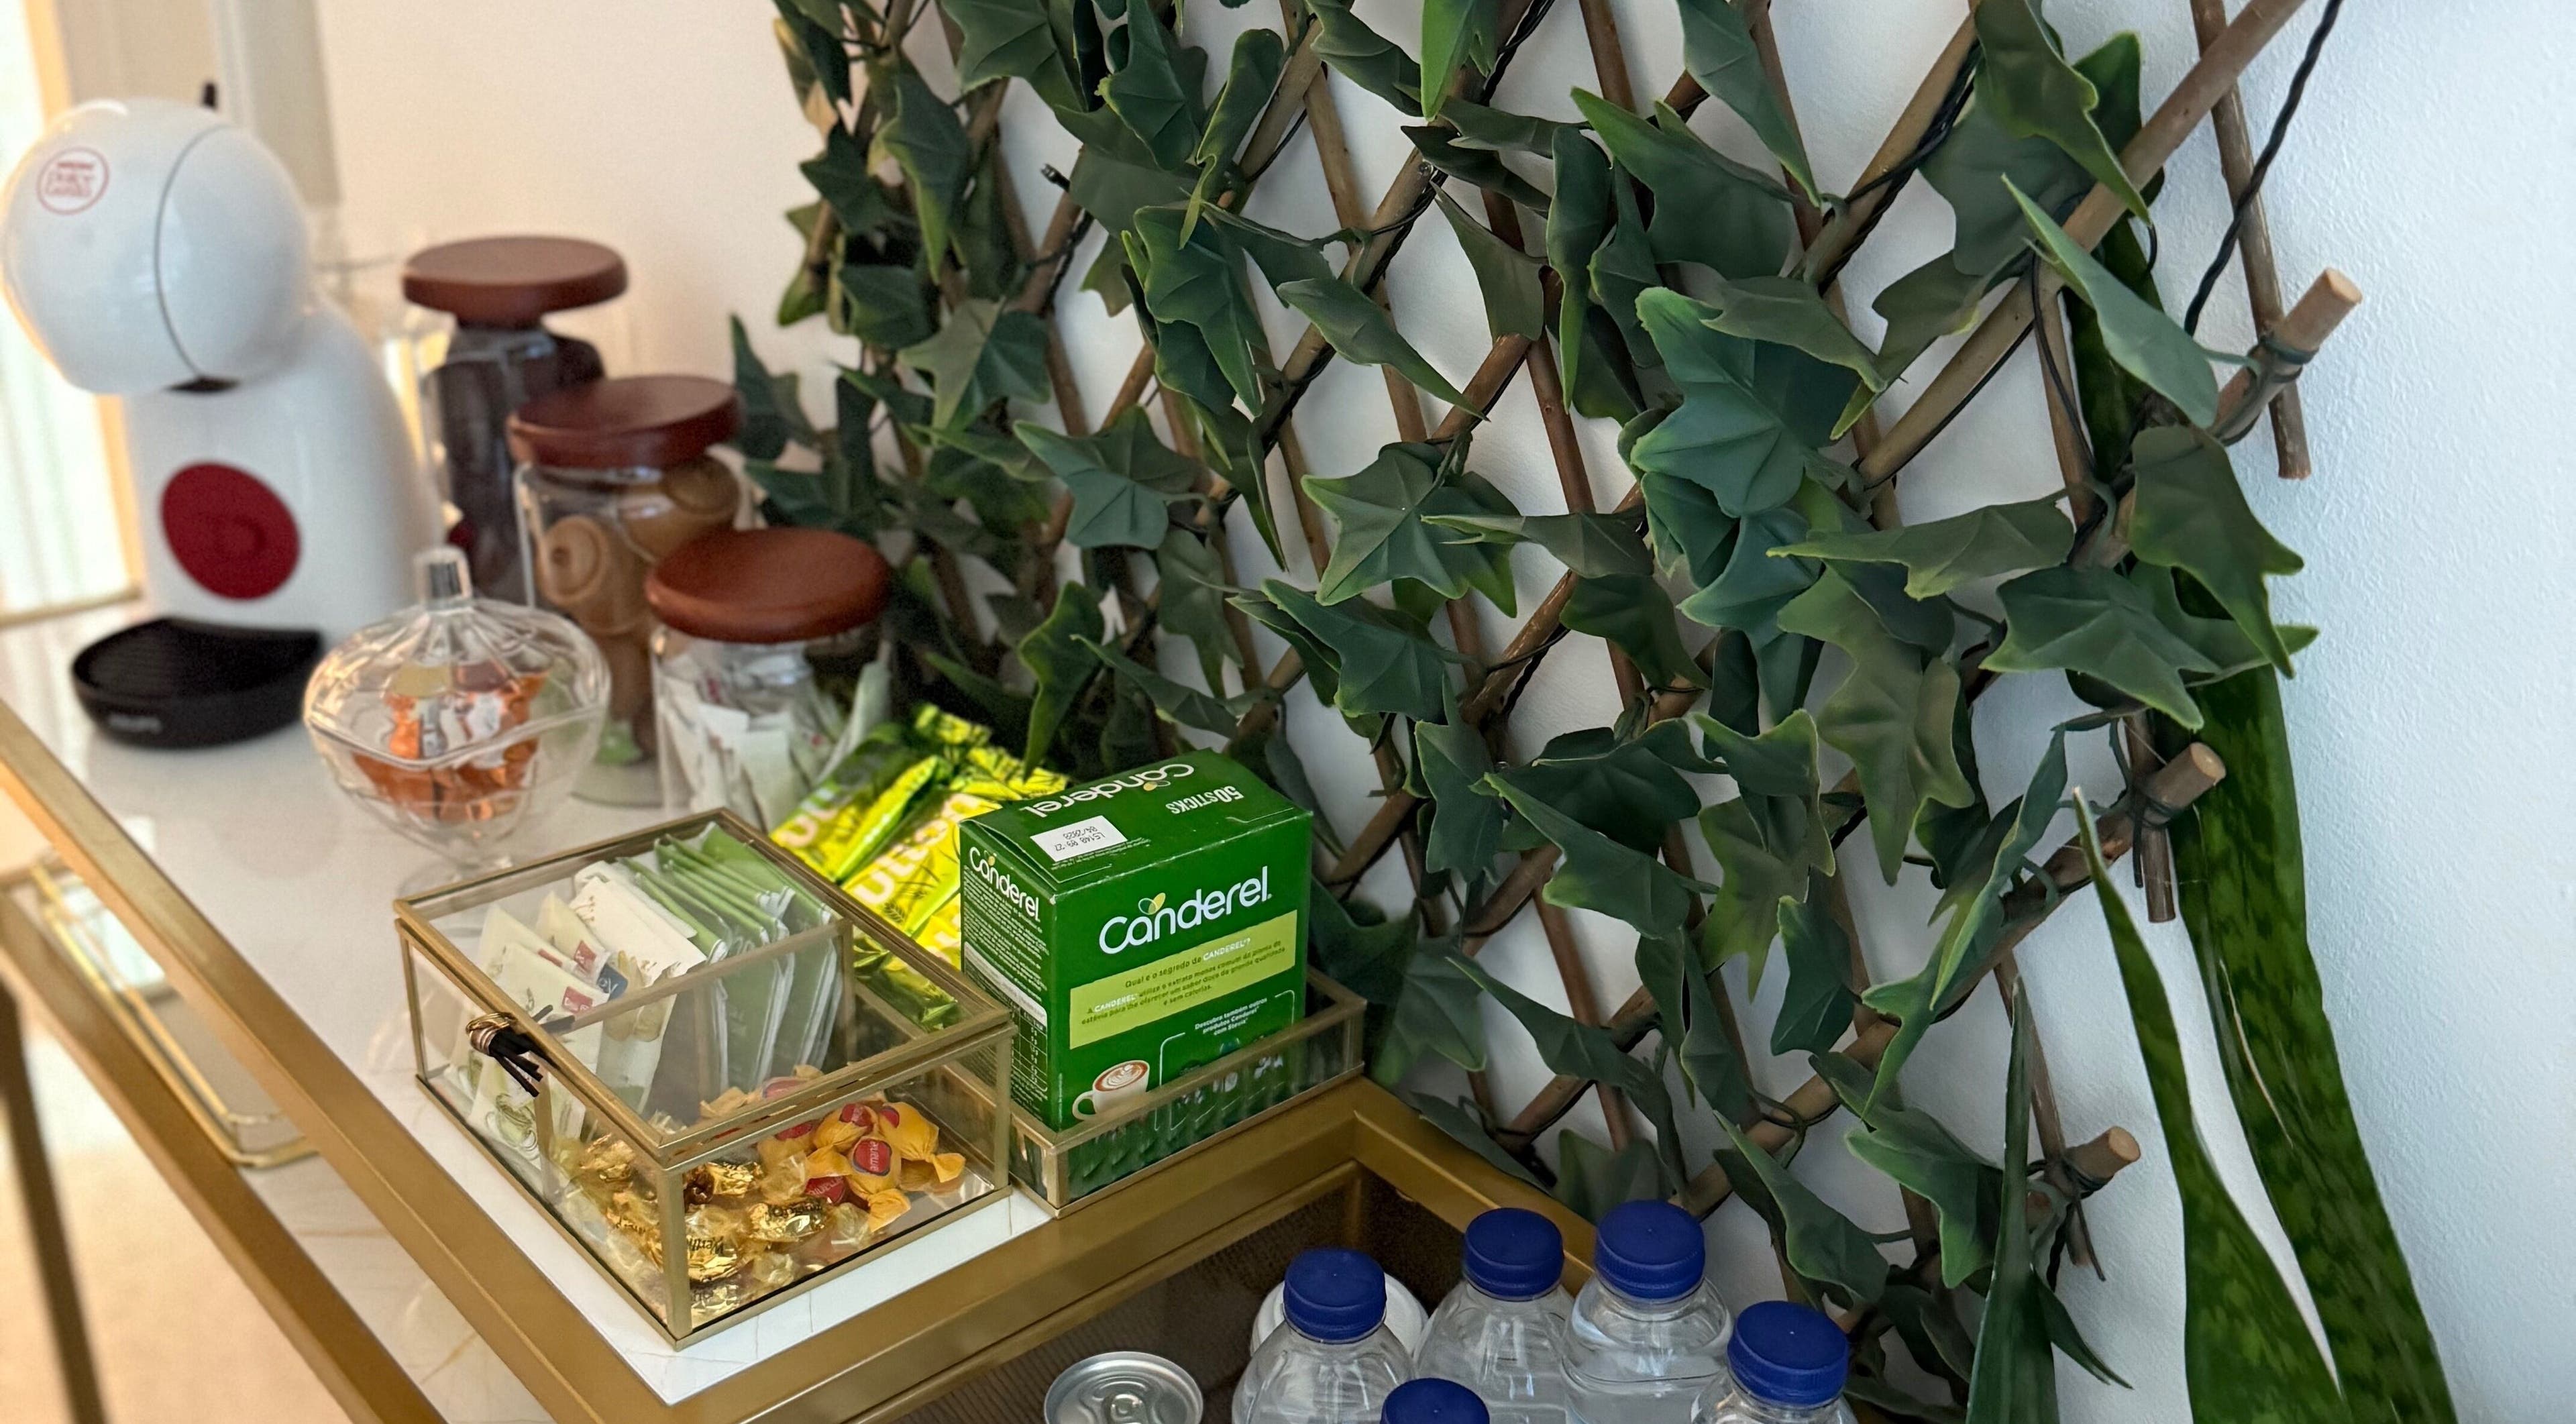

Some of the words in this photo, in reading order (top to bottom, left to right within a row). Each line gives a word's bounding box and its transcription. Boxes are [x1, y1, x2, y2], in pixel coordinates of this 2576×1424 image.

[1019, 763, 1195, 818] Canderel
[969, 846, 1040, 922] Canderel
[1099, 865, 1268, 954] Canderel
[1125, 977, 1144, 988] Qual
[1159, 961, 1190, 977] segredo
[1169, 993, 1183, 1003] sem
